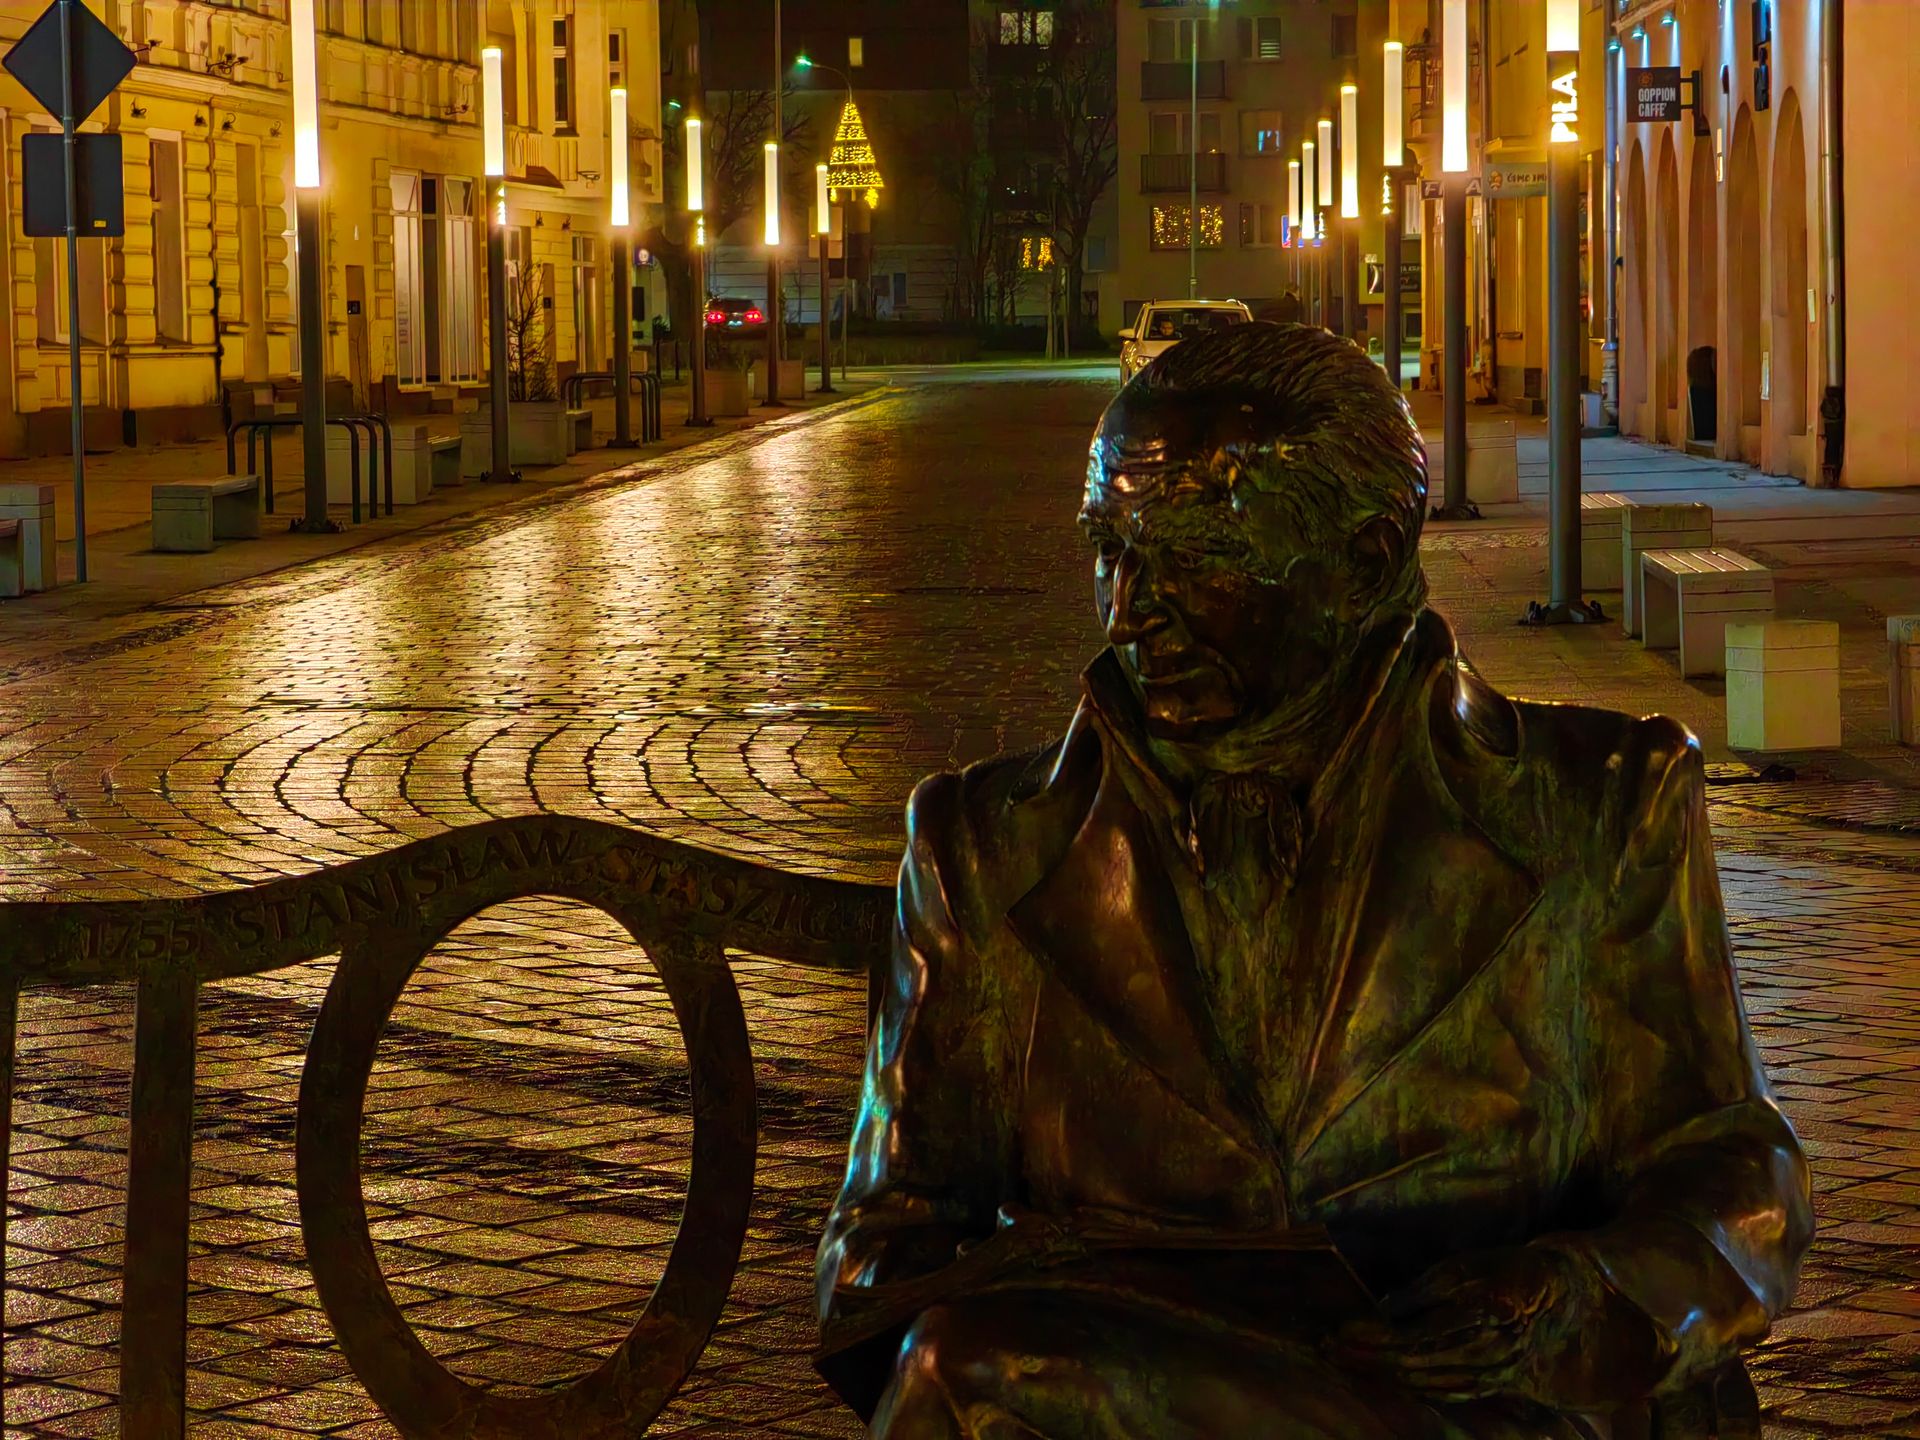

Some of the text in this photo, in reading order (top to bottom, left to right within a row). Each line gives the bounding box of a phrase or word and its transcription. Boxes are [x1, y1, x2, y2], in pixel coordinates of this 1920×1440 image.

[1550, 70, 1578, 143] PIŁA
[1638, 87, 1676, 102] GOPPION
[80, 918, 203, 962] 1755
[229, 828, 577, 950] STANISŁAW
